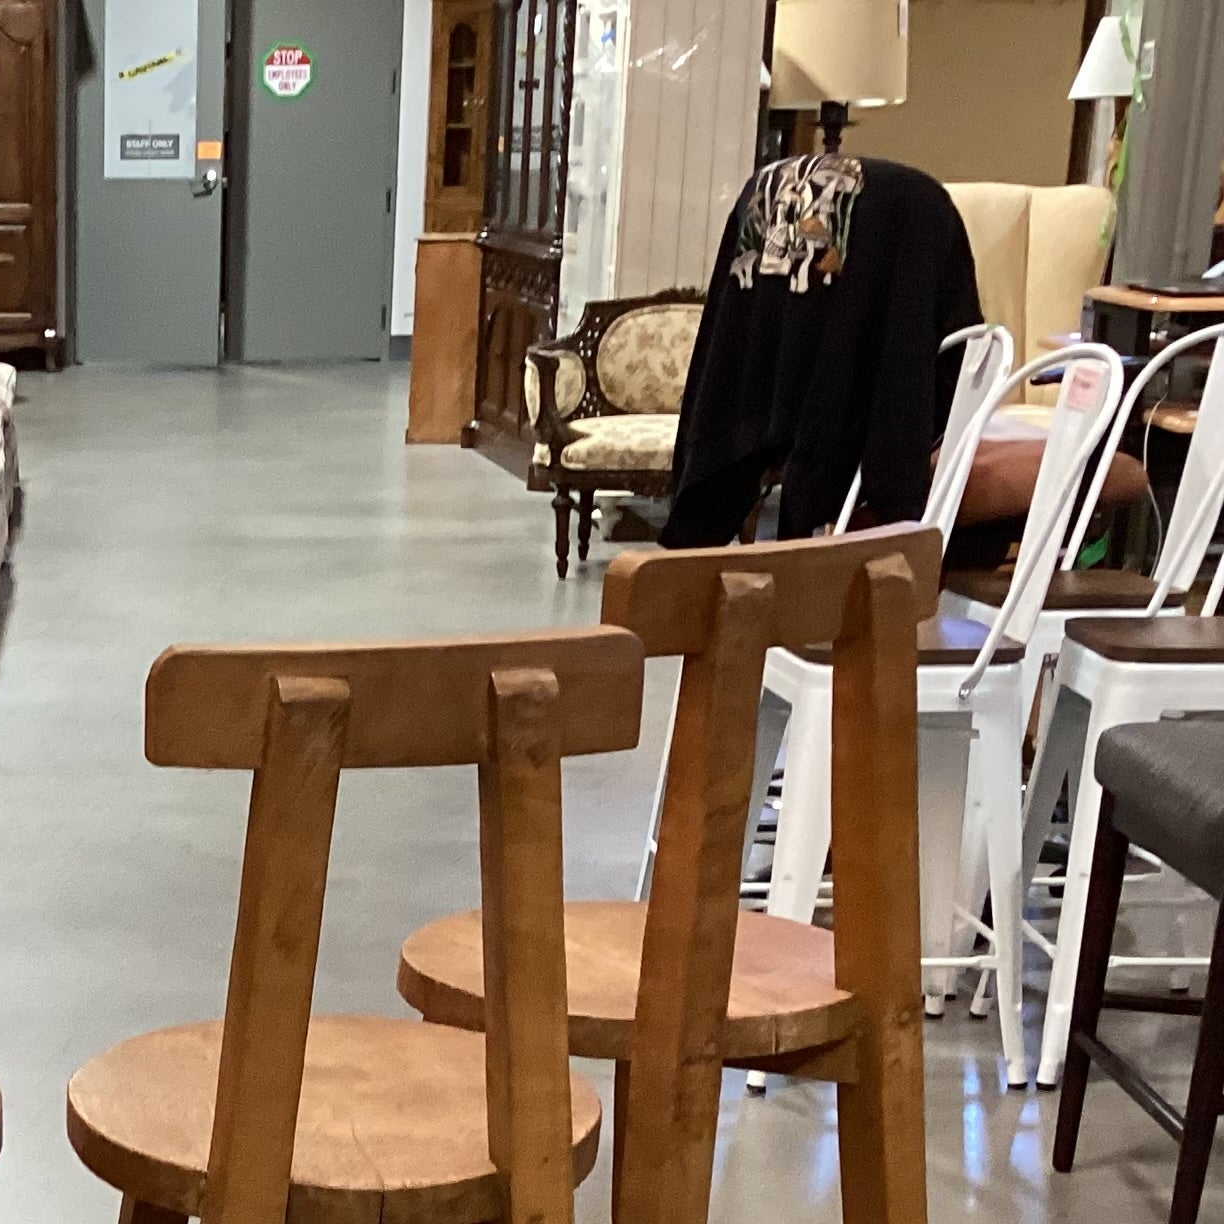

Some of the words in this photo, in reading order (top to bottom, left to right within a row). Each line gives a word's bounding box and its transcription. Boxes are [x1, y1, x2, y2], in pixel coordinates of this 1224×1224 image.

[273, 49, 303, 65] STOP
[126, 139, 150, 148] STAFF
[152, 139, 174, 148] ONLY
